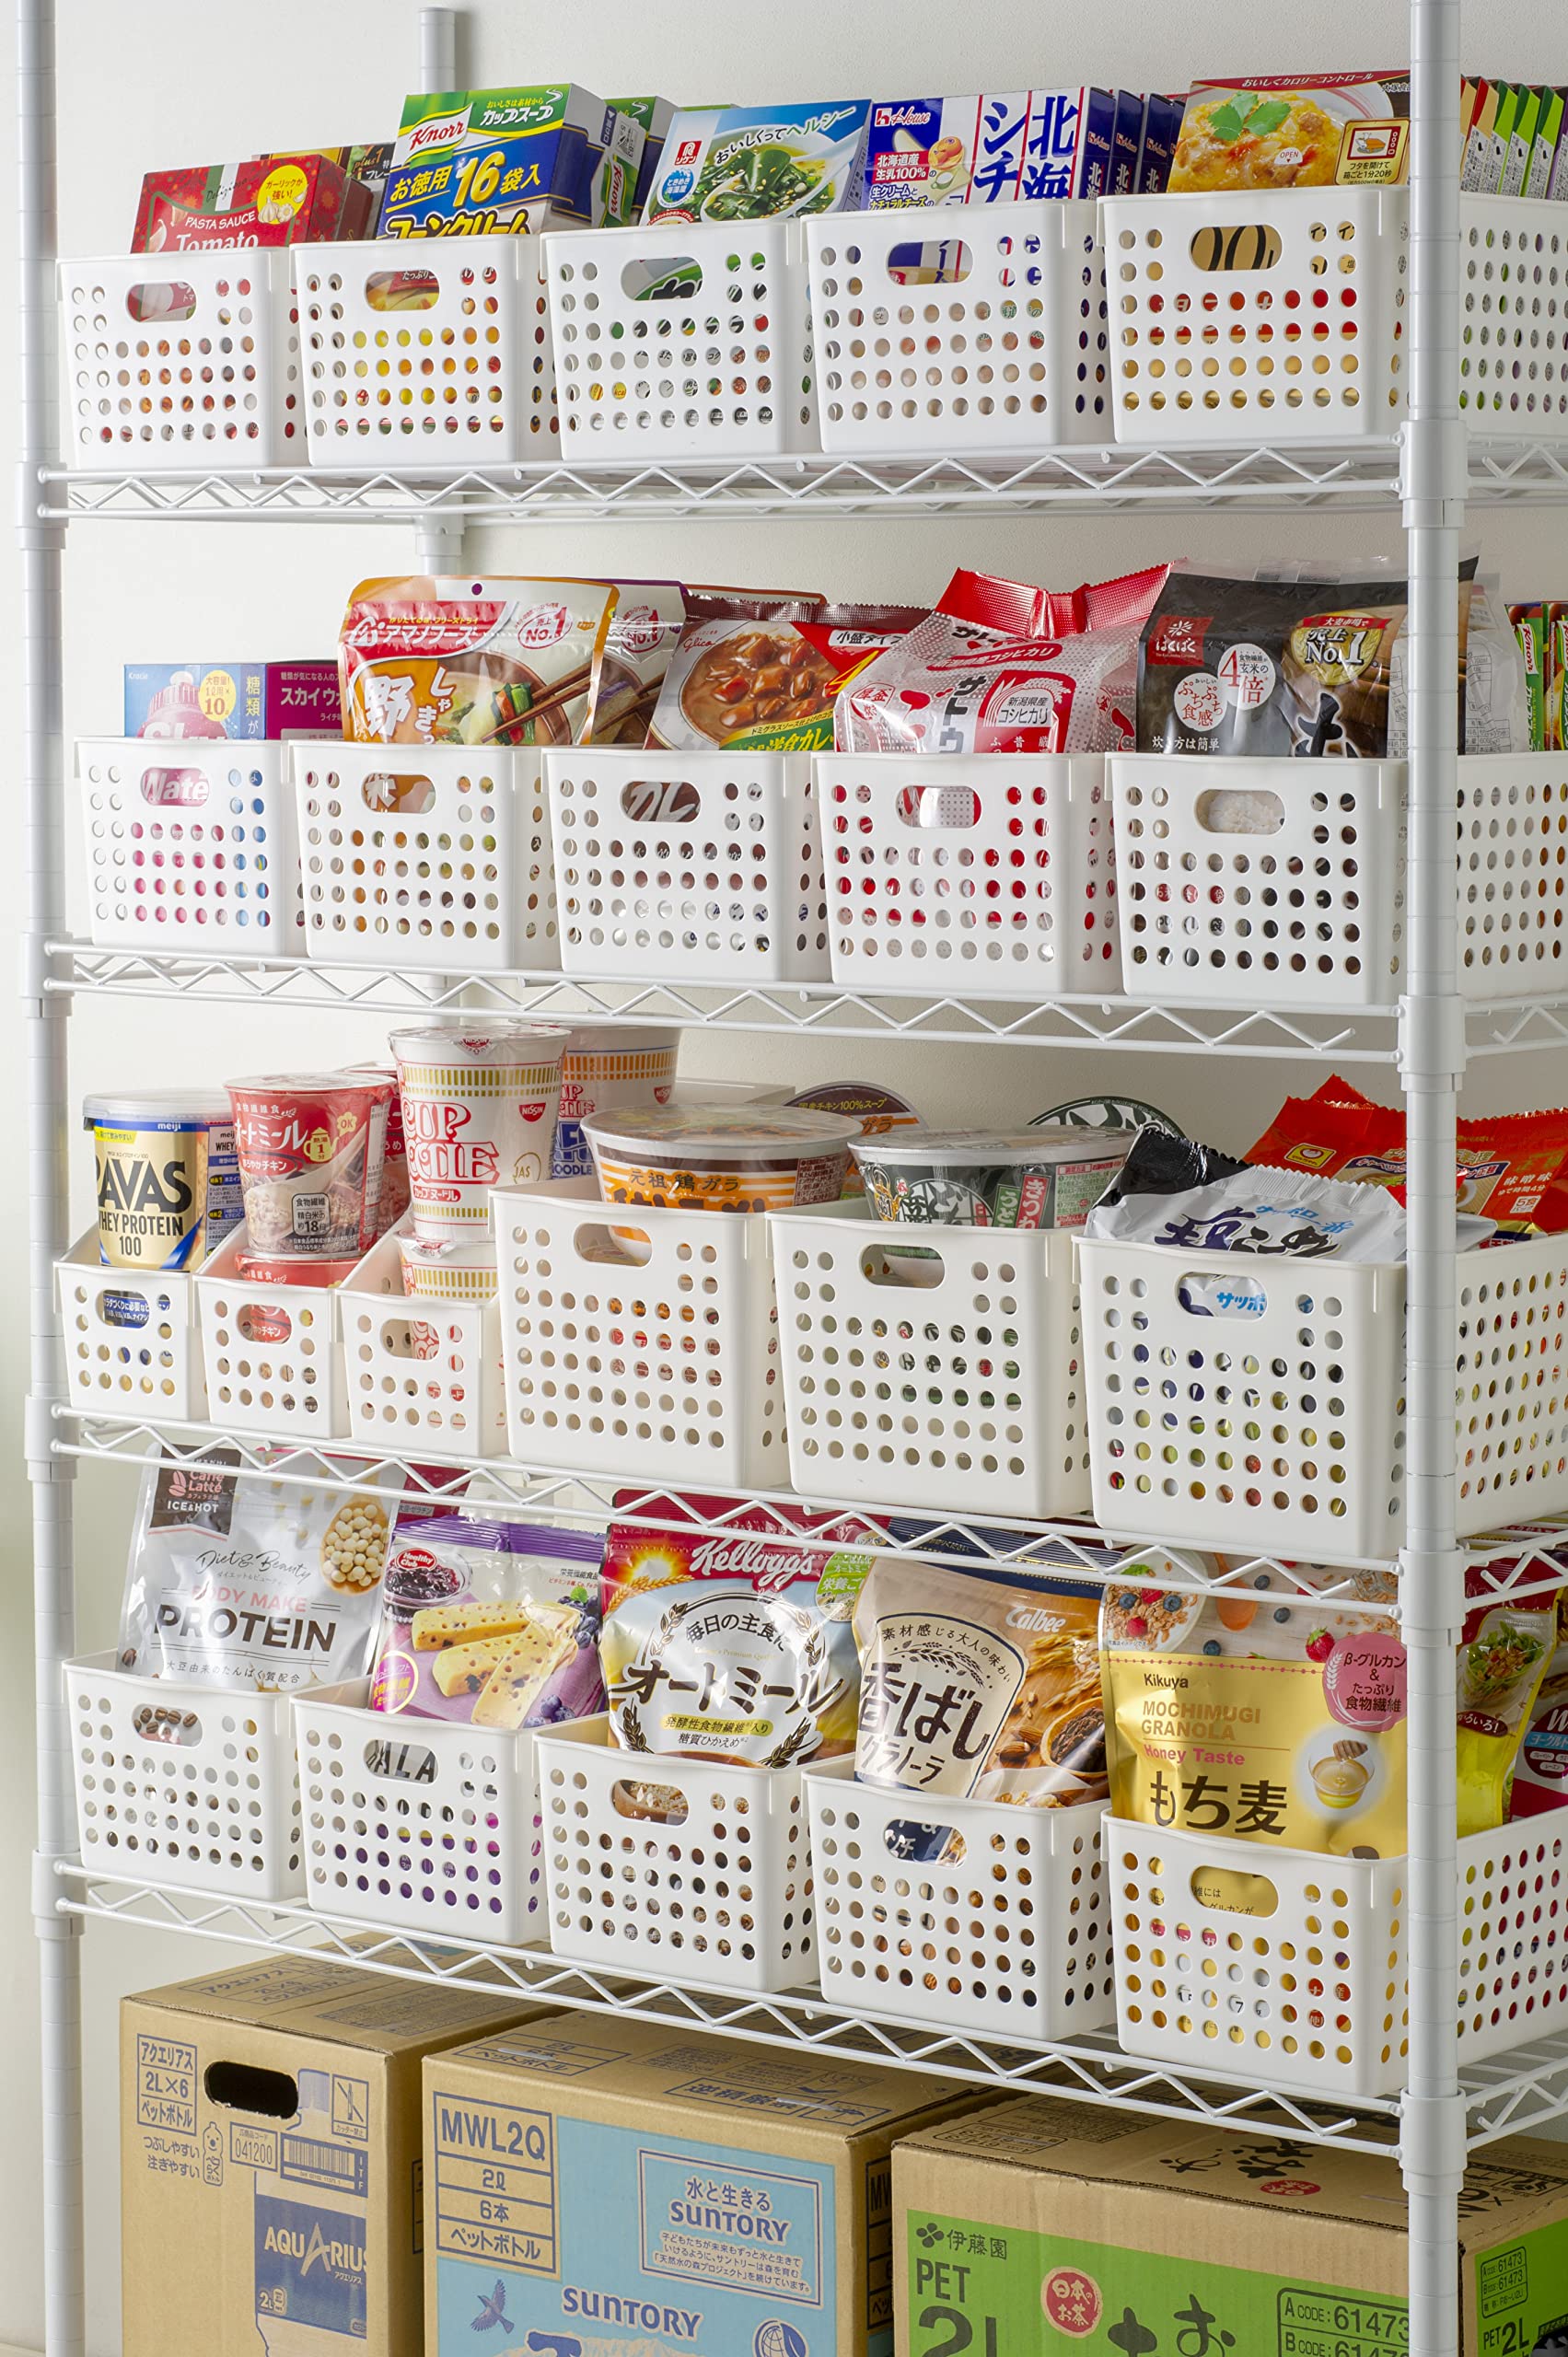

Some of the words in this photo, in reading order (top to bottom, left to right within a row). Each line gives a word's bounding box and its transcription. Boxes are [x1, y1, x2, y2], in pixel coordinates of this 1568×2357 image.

[1241, 71, 1376, 88] おいしくカロリーコントロール
[486, 97, 545, 109] おいしさは素材から
[479, 105, 554, 126] カップスープ
[891, 110, 932, 125] House
[409, 121, 464, 151] Knorr
[714, 105, 857, 166] おいしくってヘルシー
[1023, 95, 1078, 200] 北海
[1280, 150, 1300, 160] OPEN
[674, 155, 698, 166] リケン
[877, 153, 920, 168] 北海道産
[1349, 161, 1391, 170] フタを開けて
[265, 179, 304, 190] ガーリックが
[389, 165, 454, 203] お徳用
[451, 150, 506, 209] 16
[499, 163, 542, 196] 袋入
[1343, 170, 1392, 180] 箱ごと1分20秒
[610, 164, 622, 215] Knorr
[870, 184, 918, 197] 生クリームと
[184, 215, 218, 230] PASTA
[218, 211, 256, 229] SAUCE
[383, 624, 481, 645] アマノフーズ
[836, 632, 903, 645] 小盛タイプ
[1155, 637, 1197, 653] はくばく
[1307, 627, 1346, 642] 売上
[1305, 630, 1367, 667] No.1
[1522, 624, 1534, 672] Knorr
[1219, 649, 1241, 688] 4
[1238, 663, 1269, 674] 玄米の
[1240, 675, 1265, 704] 倍
[1007, 696, 1049, 707] 新潟県産
[997, 708, 1049, 726] コシヒカリ
[1182, 703, 1214, 727] 食感
[1152, 736, 1220, 751] 炊方は簡単
[522, 1106, 545, 1115] NISSIN
[157, 1121, 182, 1132] meiji
[340, 1118, 354, 1129] OK
[233, 1120, 308, 1151] オートミール
[215, 1142, 235, 1153] WHEY
[513, 1166, 531, 1179] JAS
[296, 1198, 326, 1207] 食物繊維
[122, 1214, 184, 1237] PROTEIN
[297, 1211, 326, 1220] 精白米の
[119, 1236, 142, 1257] 100
[1216, 1292, 1266, 1313] サッポ
[167, 1501, 219, 1513] ICE&HOT
[259, 1550, 312, 1585] Beauty
[400, 1559, 418, 1568] Club
[402, 1552, 434, 1565] Healthy
[688, 1537, 815, 1590] Kellogg's
[250, 1594, 308, 1613] MAKE
[154, 1604, 337, 1653] PROTEIN
[1005, 1606, 1067, 1634] Calbee
[880, 1622, 1012, 1684] 素材感じる大人の味わい
[1343, 1654, 1407, 1669] β-グルカン
[1144, 1673, 1190, 1690] Kikuya
[1369, 1669, 1380, 1682] &
[610, 1660, 845, 1715] オートミール
[1352, 1683, 1396, 1696] たっぷり
[1142, 1700, 1261, 1725] MOCHIMUGI
[1345, 1695, 1402, 1714] 食物繊維
[1141, 1719, 1236, 1741] GRANOLA
[1144, 1744, 1187, 1765] Honey
[1193, 1747, 1246, 1767] Taste
[1150, 1770, 1289, 1836] もち麦
[140, 2040, 194, 2072] アクエリアス
[145, 2071, 190, 2099] 2L×6
[140, 2100, 193, 2129] ペットボトル
[440, 2107, 547, 2163] MWL2Q
[143, 2135, 201, 2159] つぶしやすい
[235, 2137, 273, 2165] 041200
[146, 2156, 201, 2179] 注ぎやすい
[687, 2177, 771, 2212] 水と生きる
[479, 2200, 510, 2223] 6本
[670, 2200, 789, 2243] SUNTORY
[450, 2227, 541, 2261] ペットボトル
[946, 2226, 1008, 2260] 伊藤園
[1498, 2251, 1523, 2273] 61473
[333, 2271, 364, 2285] アクエリアス
[916, 2258, 971, 2304] PET
[1498, 2270, 1523, 2291] 61473
[1051, 2278, 1095, 2302] 日本の
[563, 2286, 702, 2339] SUNTORY
[1056, 2303, 1088, 2329] お茶
[1284, 2298, 1295, 2318] A
[1284, 2333, 1296, 2352] B
[1483, 2326, 1502, 2351] PET
[1502, 2317, 1530, 2357] 2L
